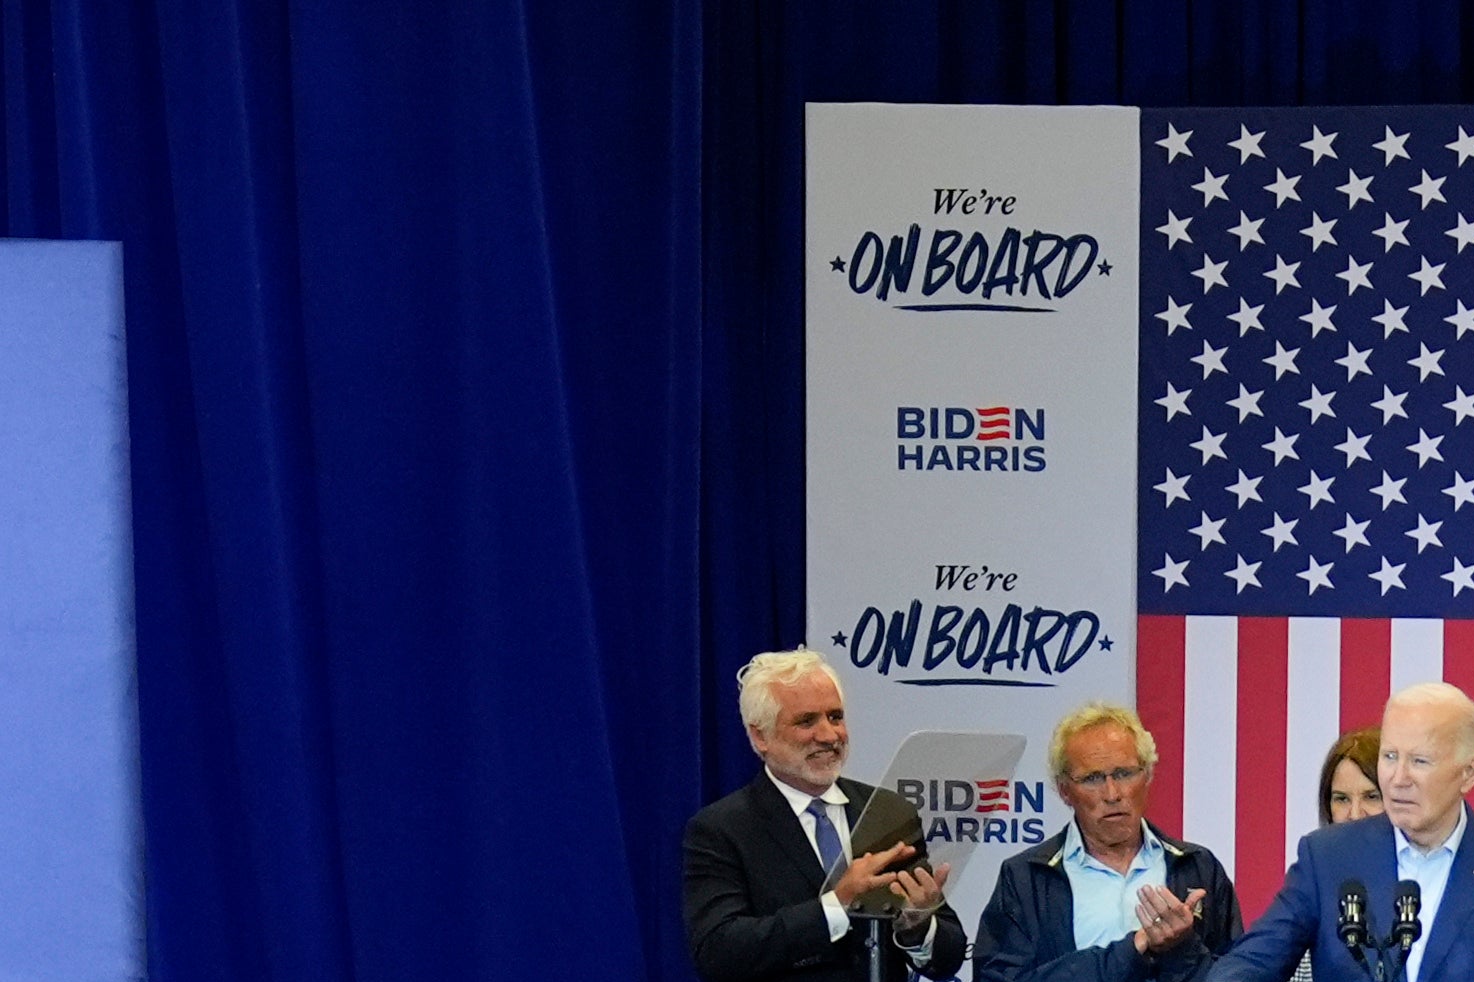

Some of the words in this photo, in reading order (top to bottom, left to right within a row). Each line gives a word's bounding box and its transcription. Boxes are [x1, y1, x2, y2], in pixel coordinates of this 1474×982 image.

[933, 188, 1017, 215] We're
[849, 223, 921, 301] ON
[921, 227, 1099, 300] BOARD
[897, 407, 1045, 441] BIDEN
[897, 445, 1047, 472] HARRIS
[935, 565, 1018, 592] We're
[850, 599, 922, 676] ON
[923, 604, 1100, 675] BOARD
[897, 779, 1044, 813] BIDEN
[925, 816, 1046, 844] ARRIS
